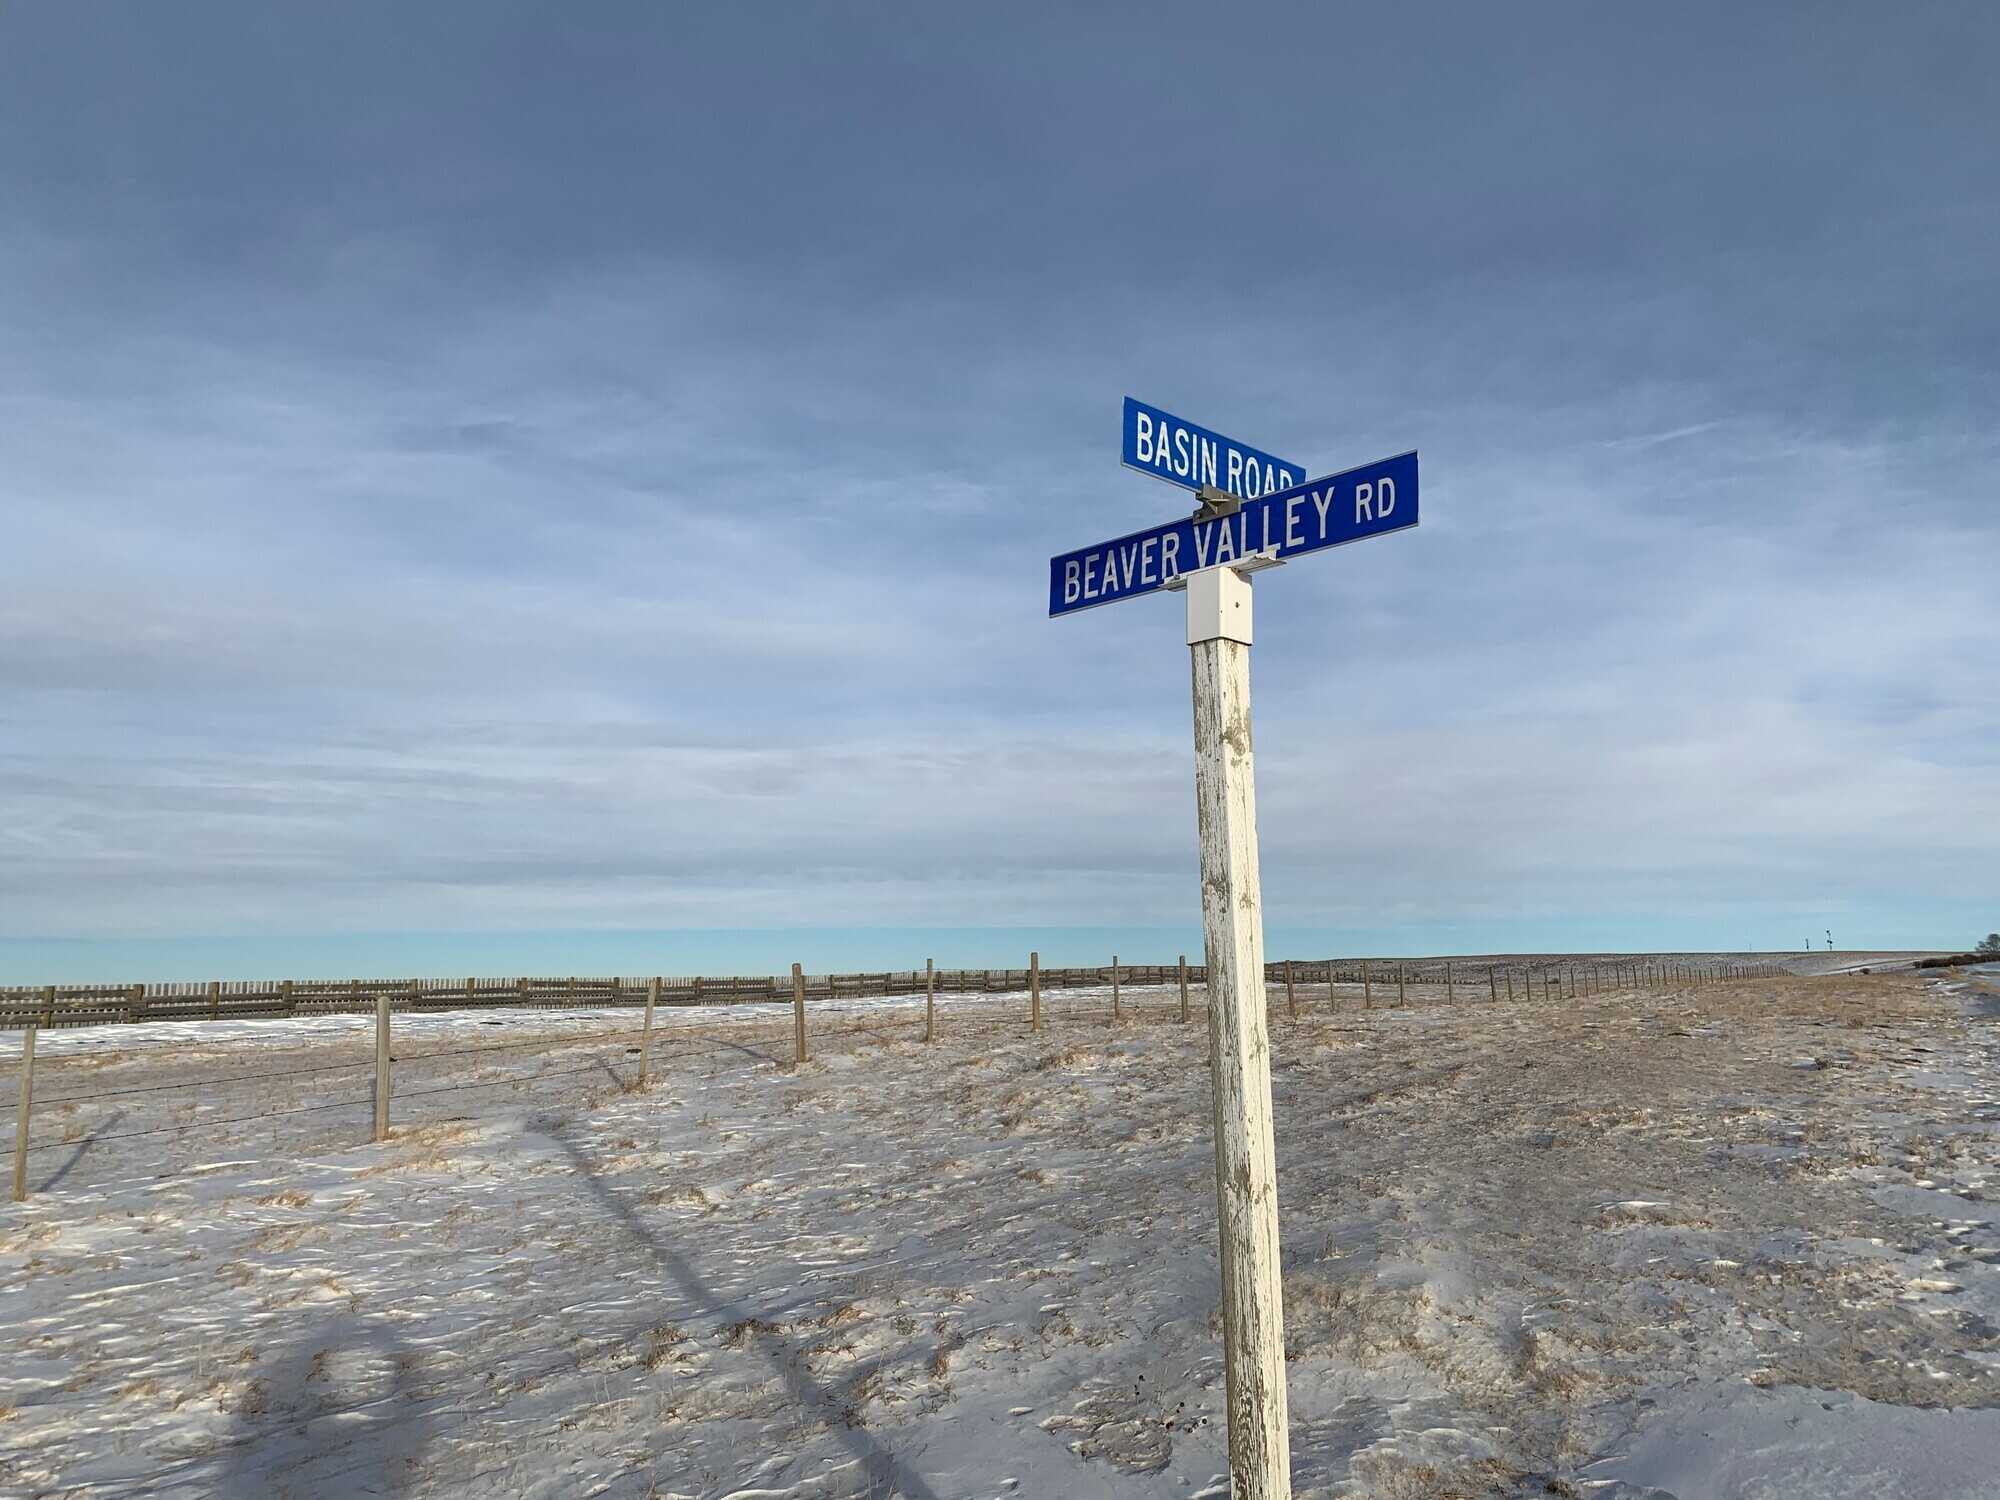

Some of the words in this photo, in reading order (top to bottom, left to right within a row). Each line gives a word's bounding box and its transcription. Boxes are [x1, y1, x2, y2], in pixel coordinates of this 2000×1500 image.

[1136, 411, 1218, 488] BASIN
[1064, 531, 1181, 604] BEAVER
[1193, 486, 1336, 568] VALLEY
[1355, 477, 1397, 524] RD
